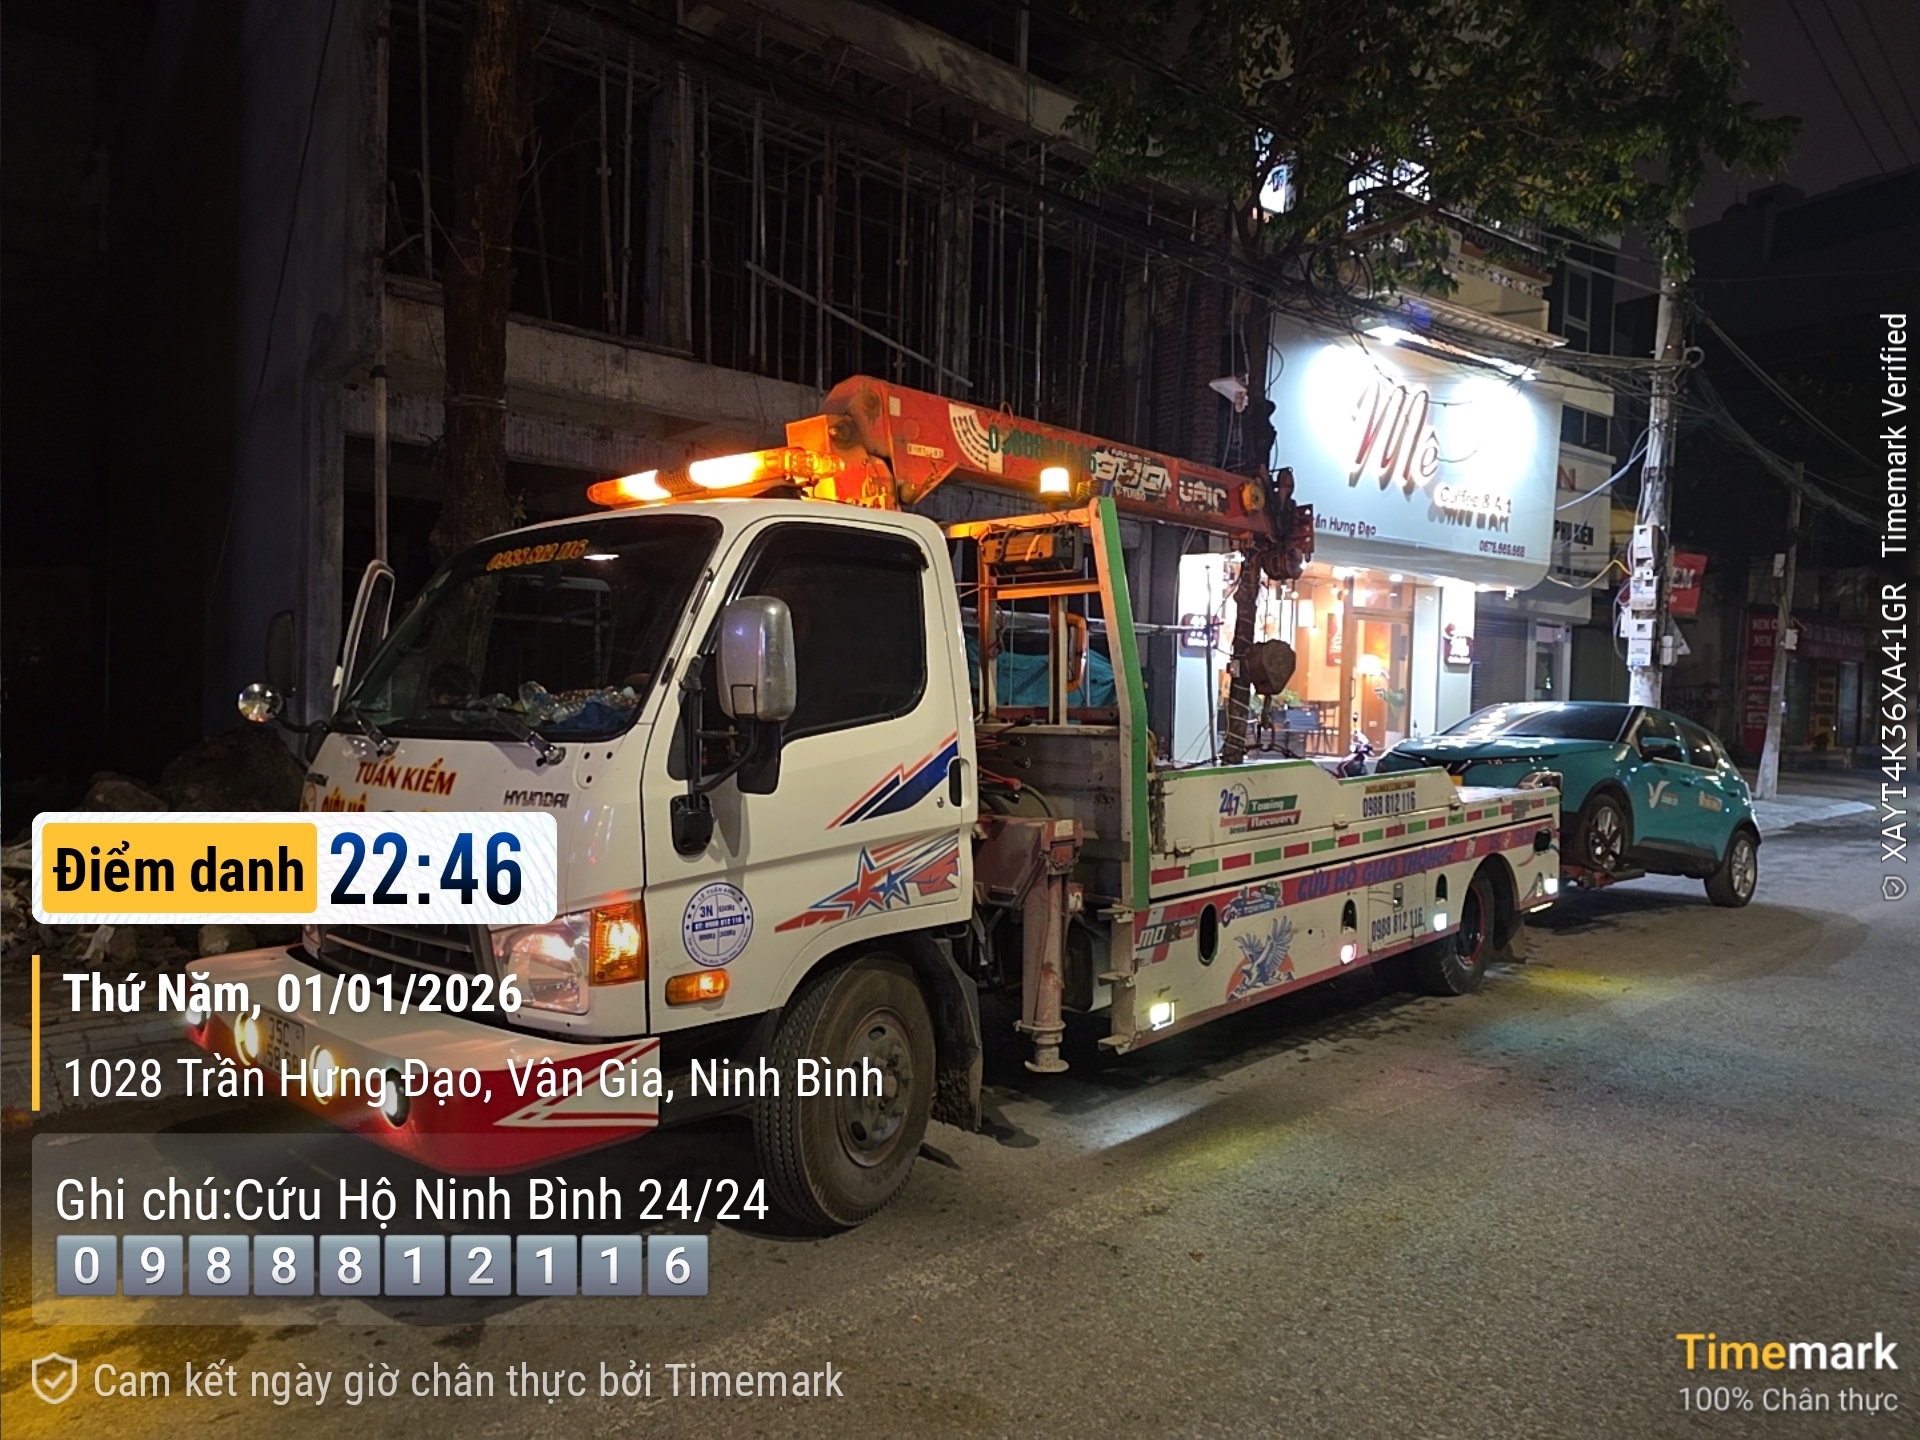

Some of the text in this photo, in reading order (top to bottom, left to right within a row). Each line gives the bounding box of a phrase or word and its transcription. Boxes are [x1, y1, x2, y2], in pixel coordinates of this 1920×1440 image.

[401, 758, 457, 797] KIỂM
[504, 790, 570, 809] HYUNDAI
[1363, 791, 1416, 818] 0988 812 116
[700, 904, 713, 918] 3N
